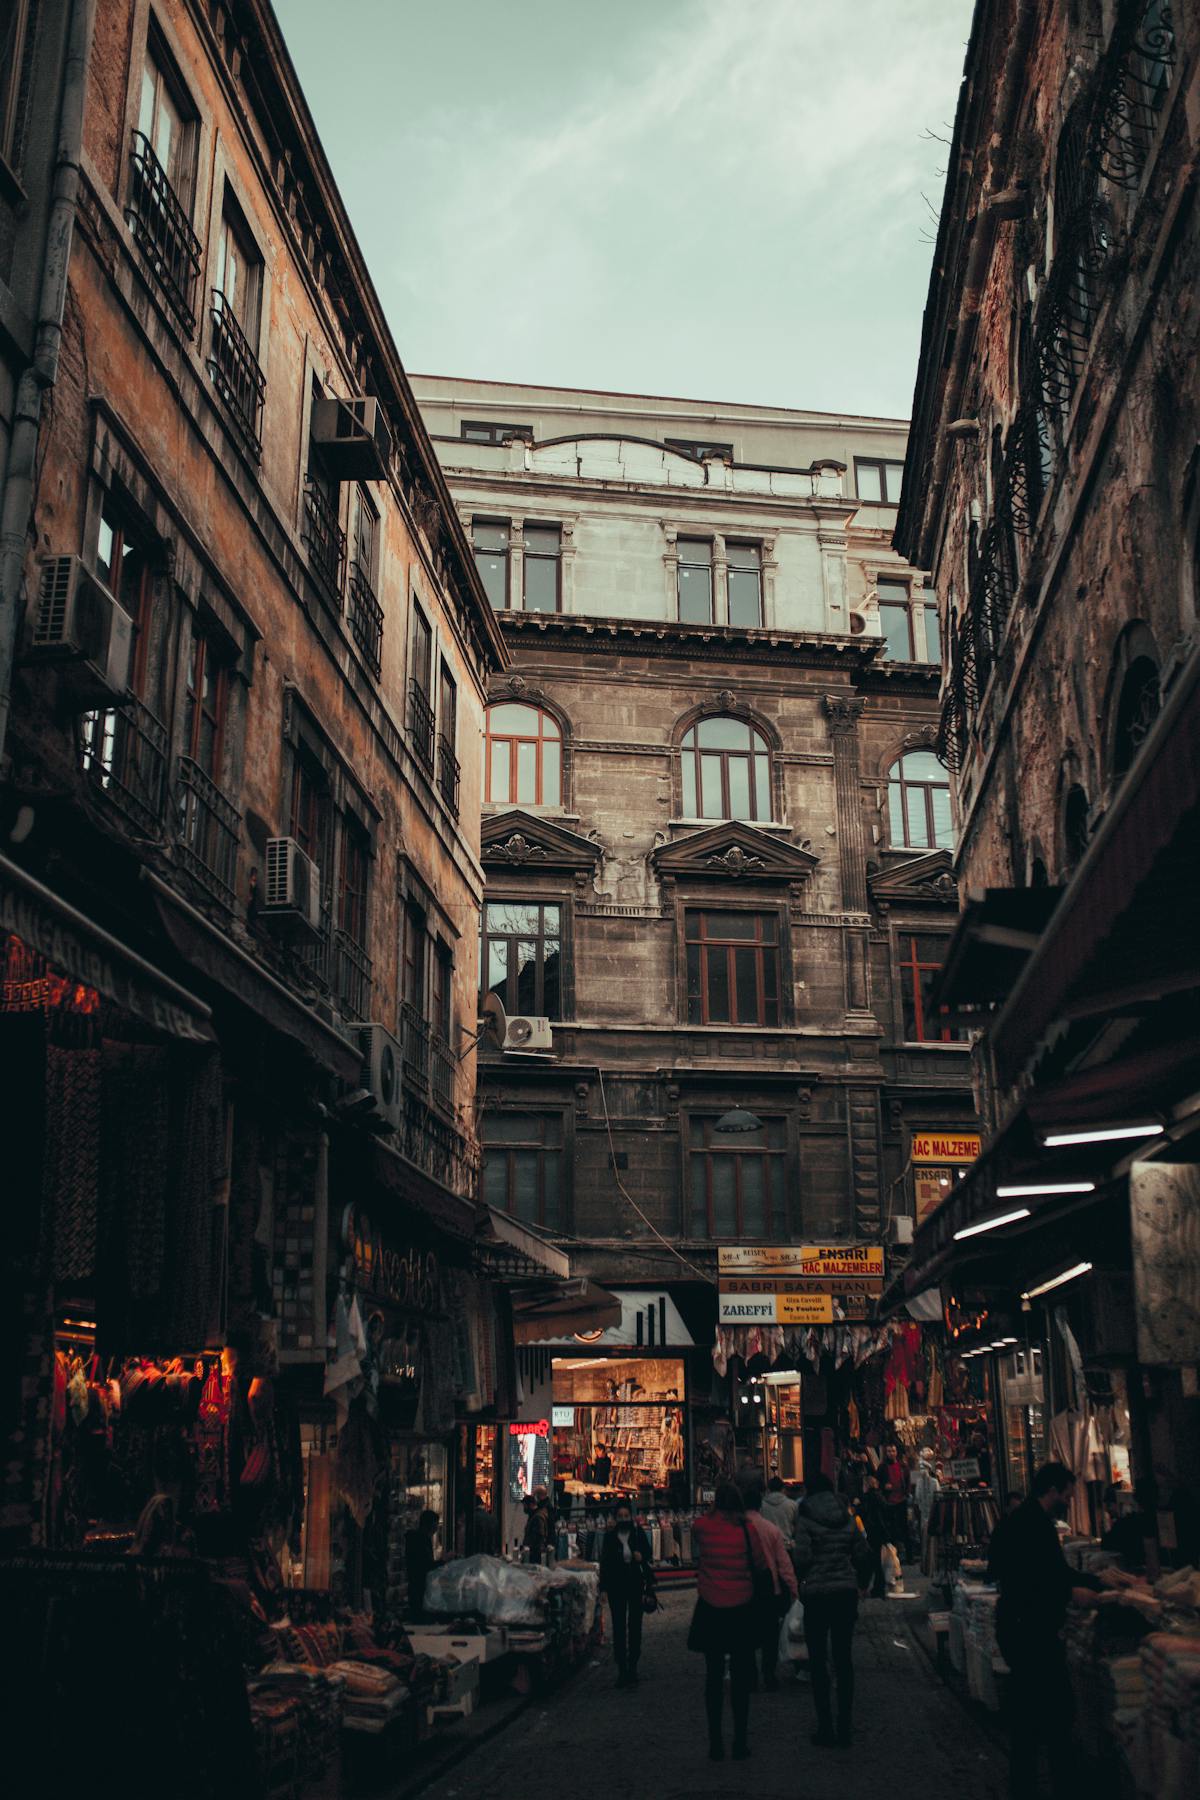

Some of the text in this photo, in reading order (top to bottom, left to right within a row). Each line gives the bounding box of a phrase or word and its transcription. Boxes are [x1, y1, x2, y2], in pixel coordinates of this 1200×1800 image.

[819, 1247, 868, 1260] ENSARİ
[802, 1262, 820, 1273] HAC
[784, 1282, 825, 1292] SAFA
[723, 1302, 773, 1316] ZAREFFİ
